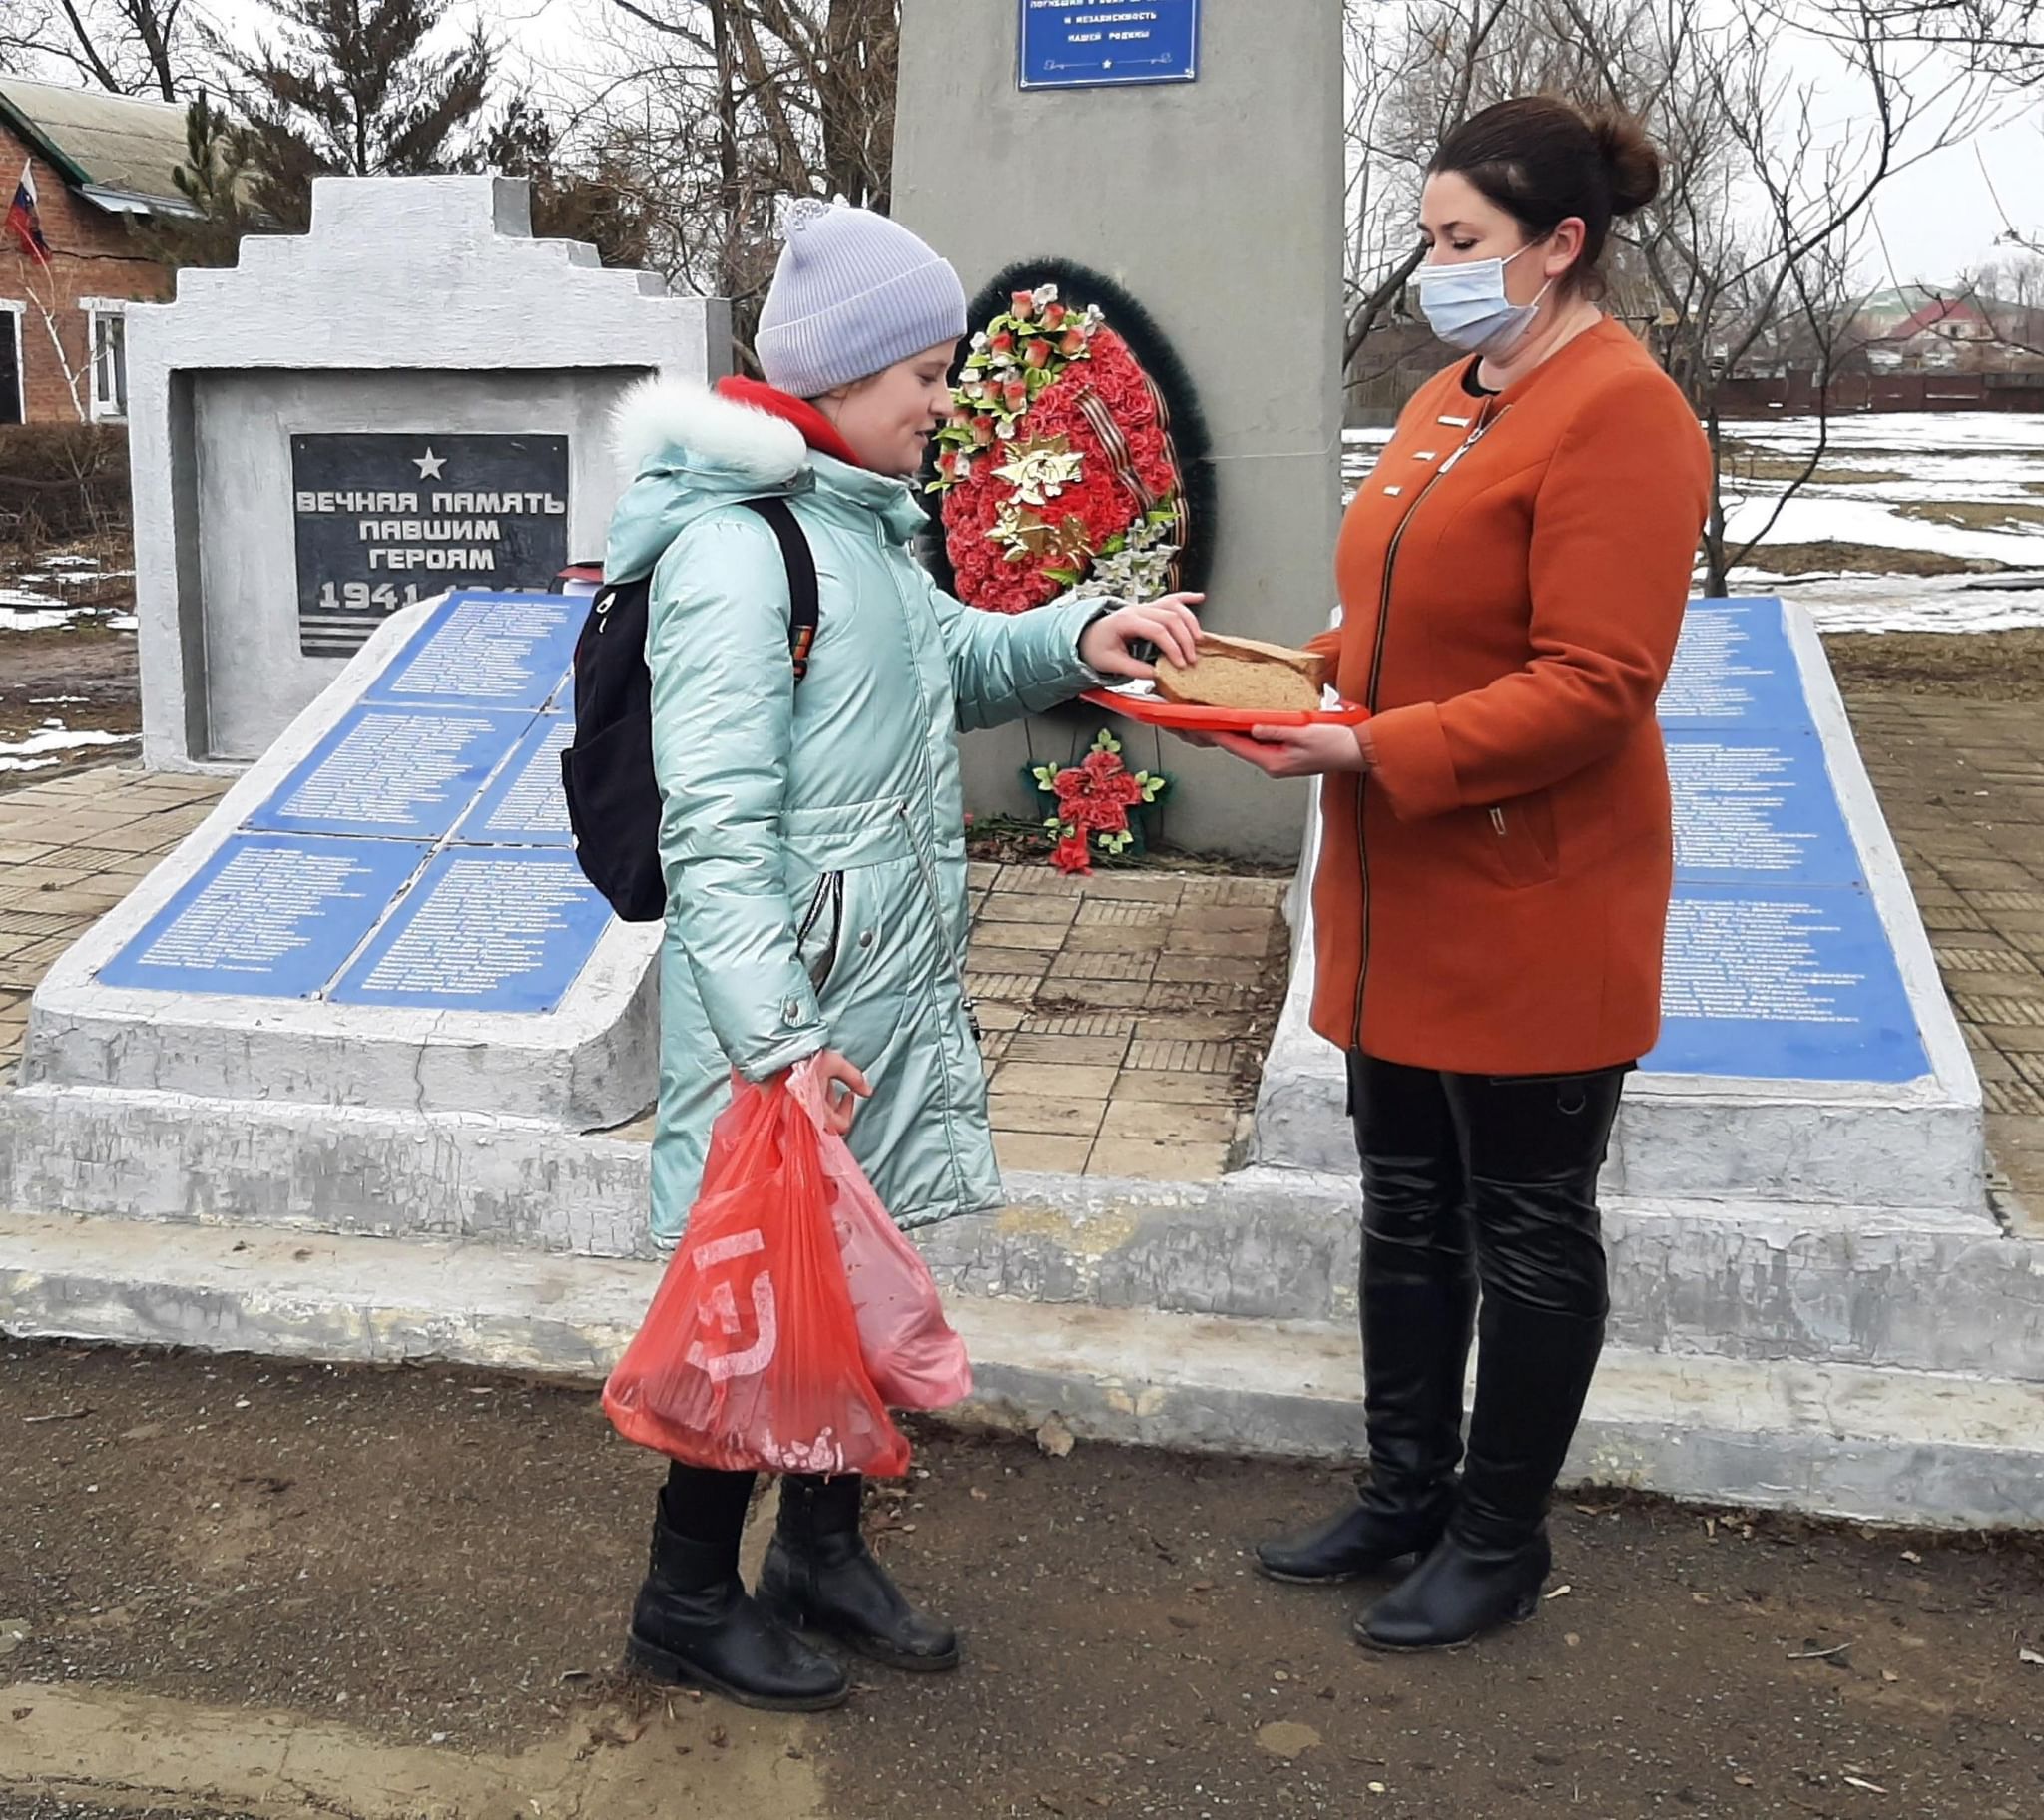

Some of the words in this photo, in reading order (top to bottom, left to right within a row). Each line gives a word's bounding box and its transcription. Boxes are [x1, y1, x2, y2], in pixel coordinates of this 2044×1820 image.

[1076, 12, 1157, 24] НЕЗАВИСИМОСТЬ
[1068, 32, 1102, 42] НАШЕЙ
[296, 492, 418, 513] ВЕЧНАЯ
[432, 492, 566, 515] ПАМЯТЬ
[359, 520, 501, 541] ПАВШИМ
[369, 548, 496, 571] ГЕРОЯМ
[319, 581, 419, 611] 1941
